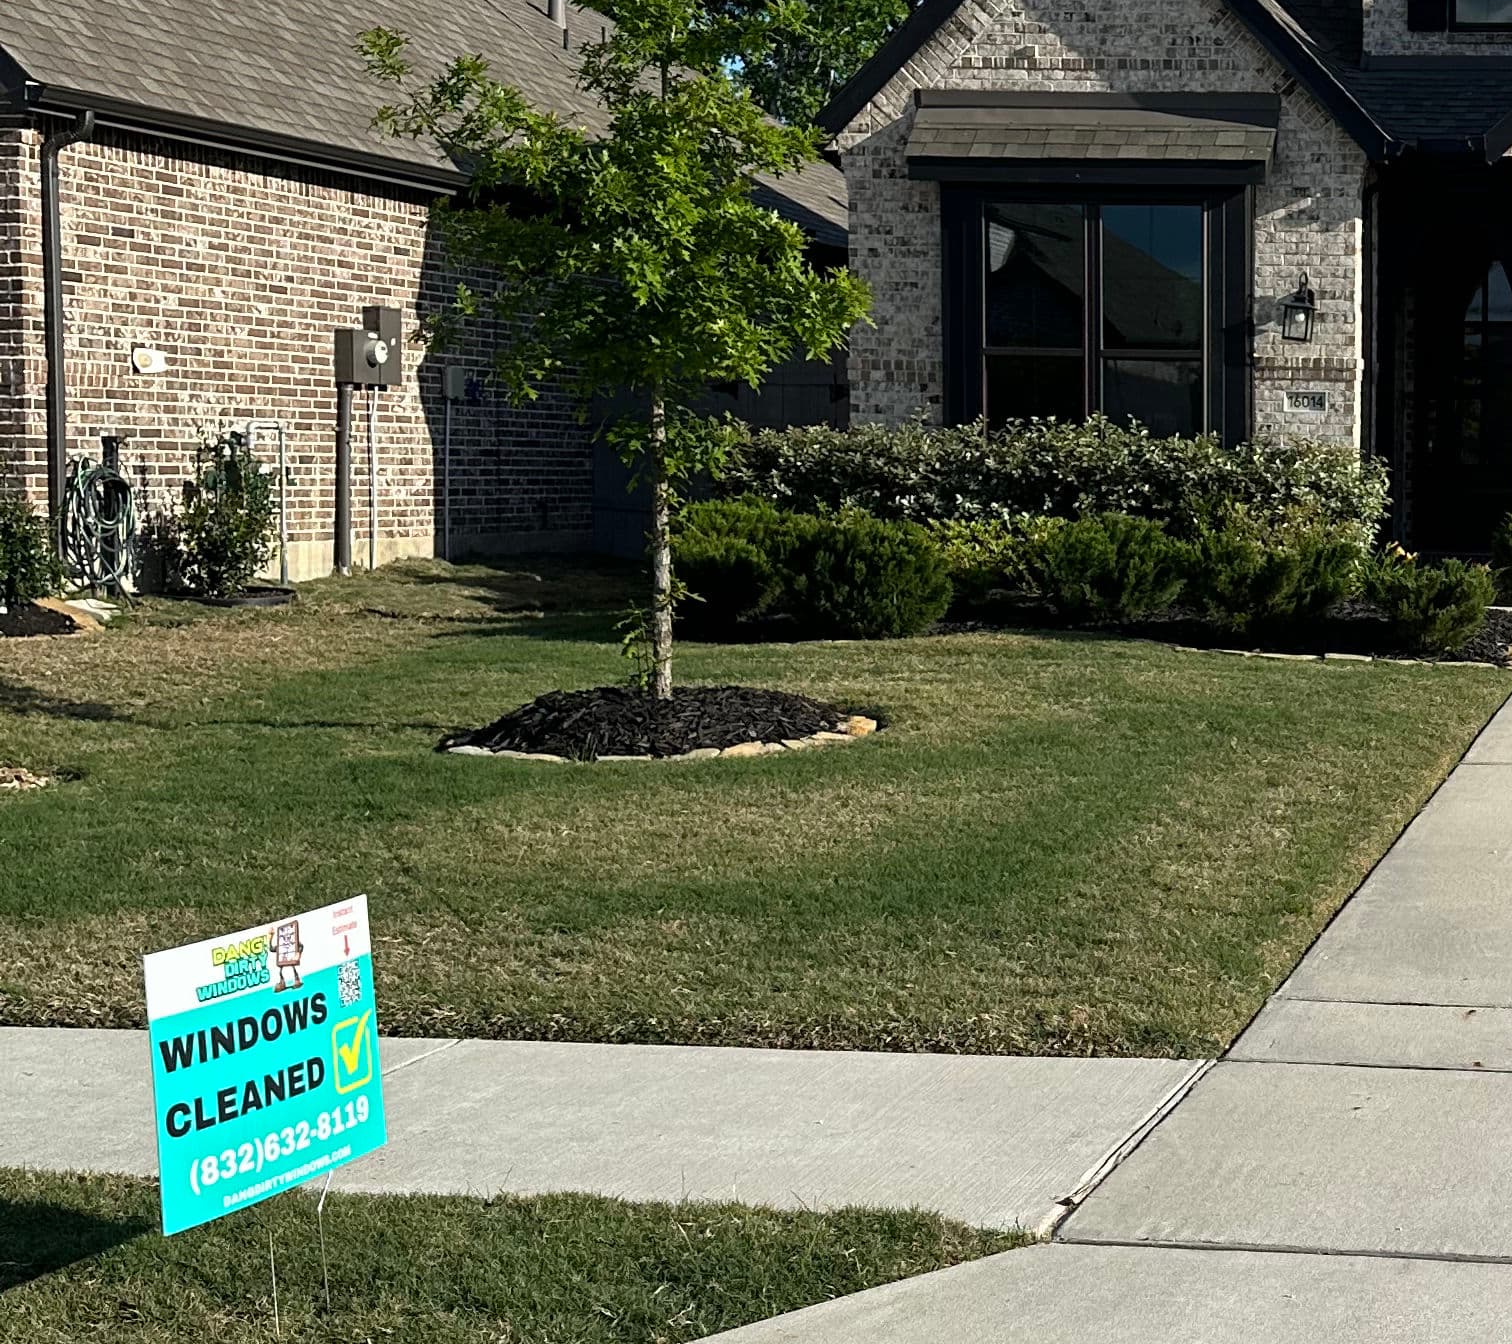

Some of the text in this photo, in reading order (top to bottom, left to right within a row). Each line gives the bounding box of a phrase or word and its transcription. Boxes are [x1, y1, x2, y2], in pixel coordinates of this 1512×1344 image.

[1288, 395, 1323, 408] 16014
[196, 968, 270, 1002] WINDOWS
[224, 951, 268, 978] DIRTY
[159, 992, 328, 1073] WINDOWS
[166, 1056, 325, 1138] CLEANED
[190, 1095, 370, 1195] (832)632-8119
